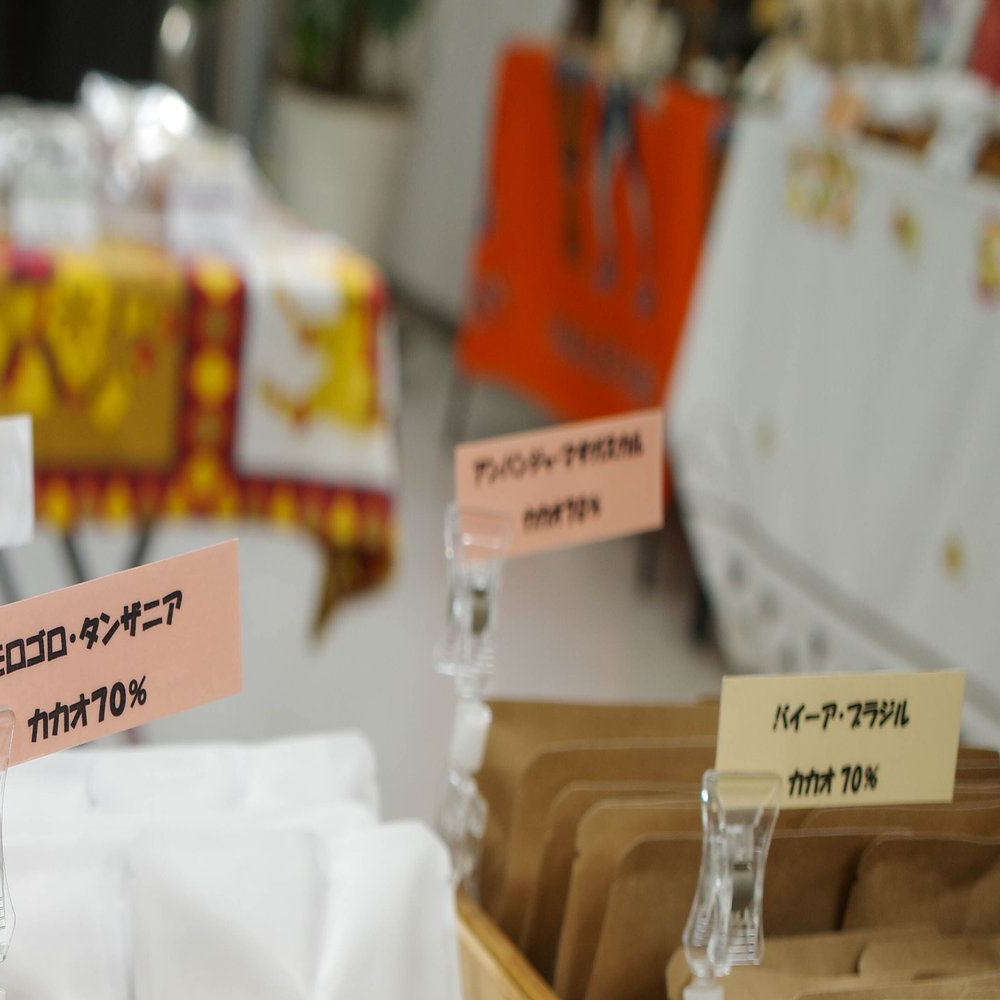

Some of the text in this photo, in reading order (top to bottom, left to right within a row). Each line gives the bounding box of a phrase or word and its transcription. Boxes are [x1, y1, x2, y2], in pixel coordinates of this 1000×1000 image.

[28, 676, 146, 742] カカオ70%
[773, 699, 910, 731] バイーア・ブラジル
